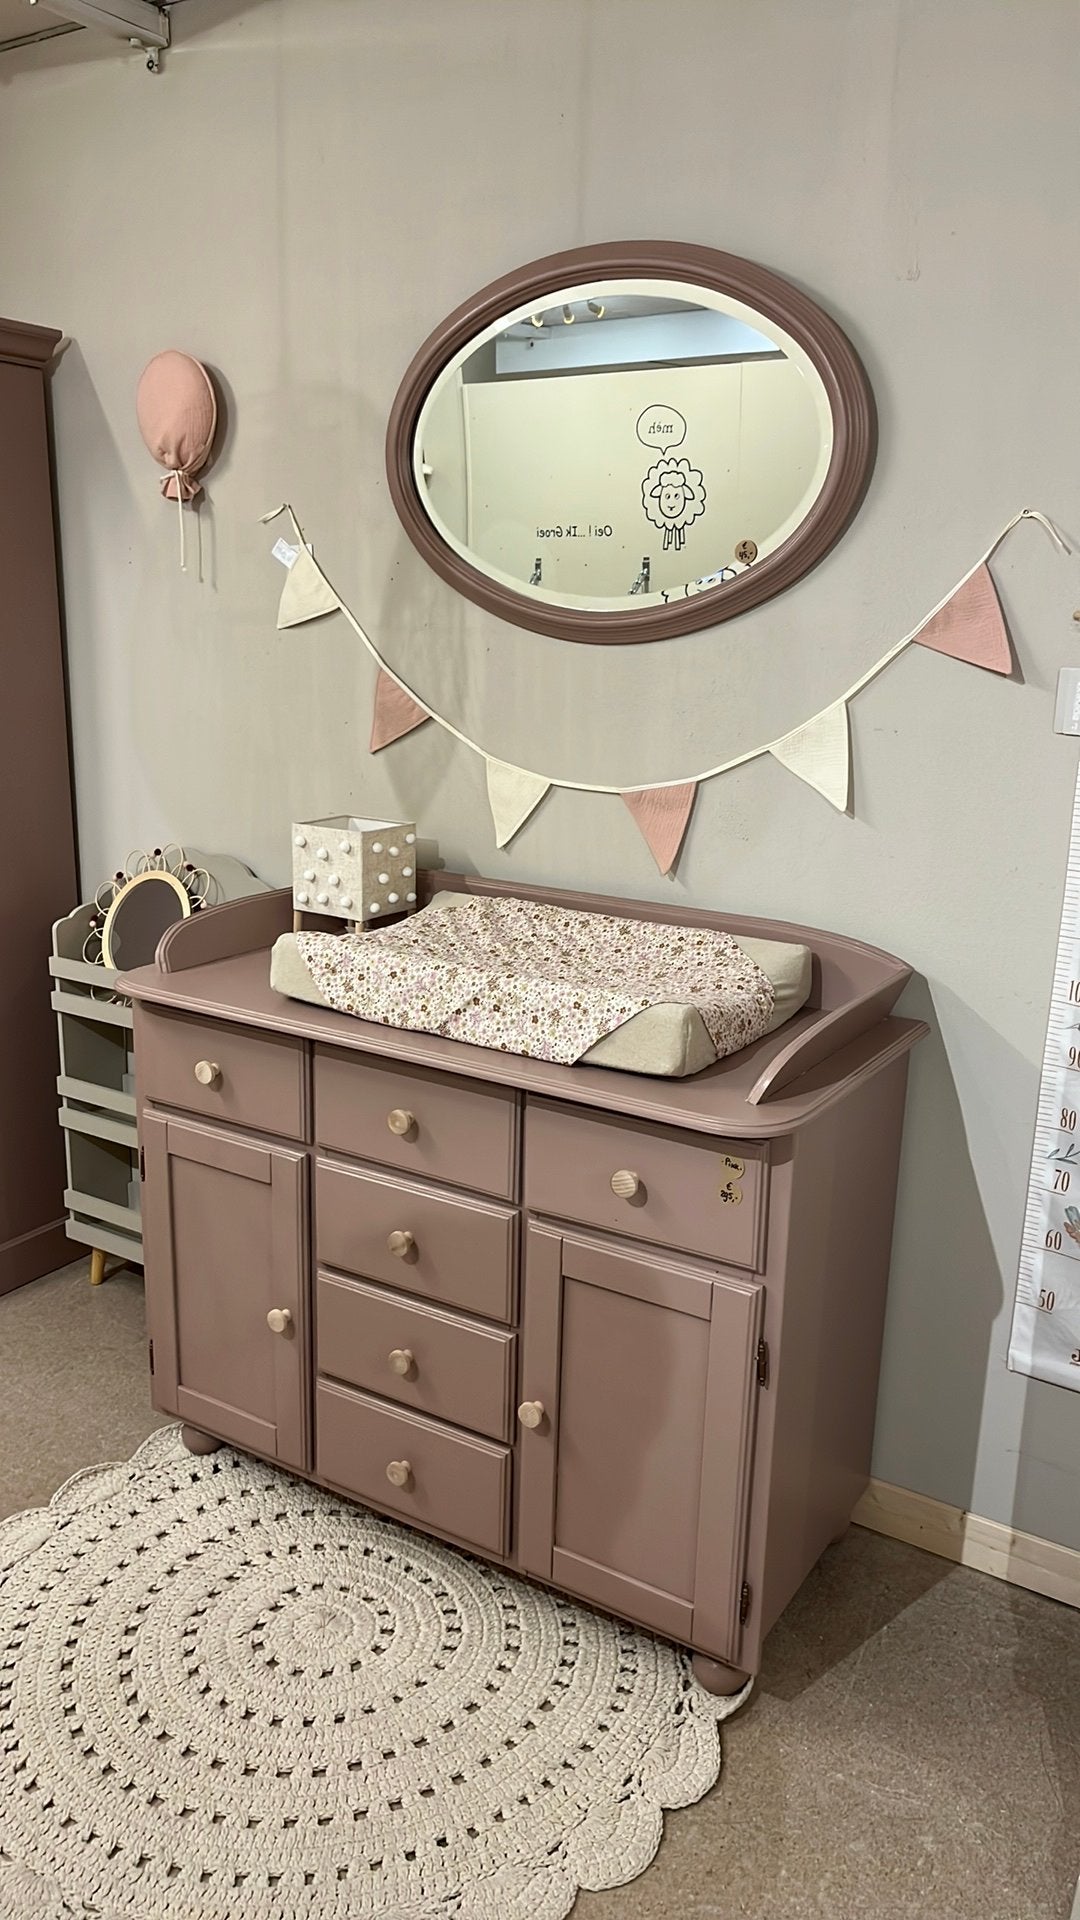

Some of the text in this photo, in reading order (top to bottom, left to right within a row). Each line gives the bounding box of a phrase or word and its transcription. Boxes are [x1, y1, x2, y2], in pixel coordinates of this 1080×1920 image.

[1060, 1107, 1077, 1131] 80
[1053, 1168, 1070, 1192] 70
[1045, 1229, 1062, 1250] 60
[1039, 1289, 1055, 1311] 50
